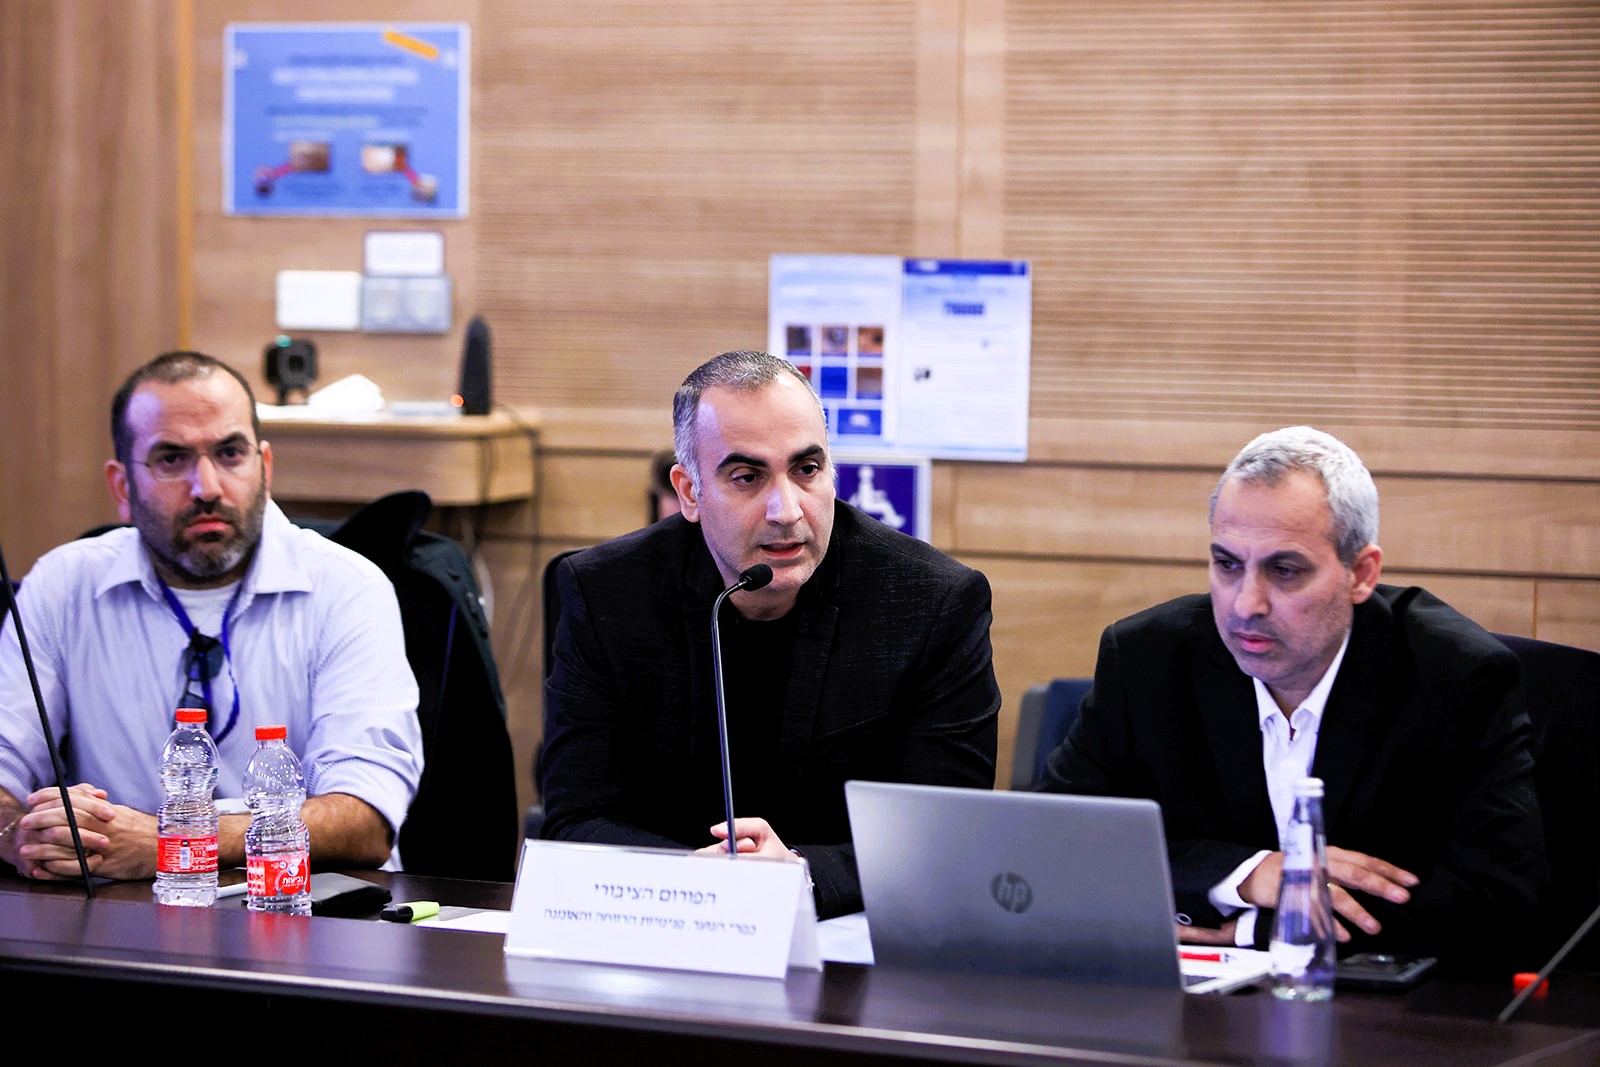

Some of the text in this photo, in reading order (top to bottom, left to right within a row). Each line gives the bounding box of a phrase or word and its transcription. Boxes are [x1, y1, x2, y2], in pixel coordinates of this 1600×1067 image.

[594, 884, 717, 905] הפורום הציבורי
[994, 872, 1031, 914] hp
